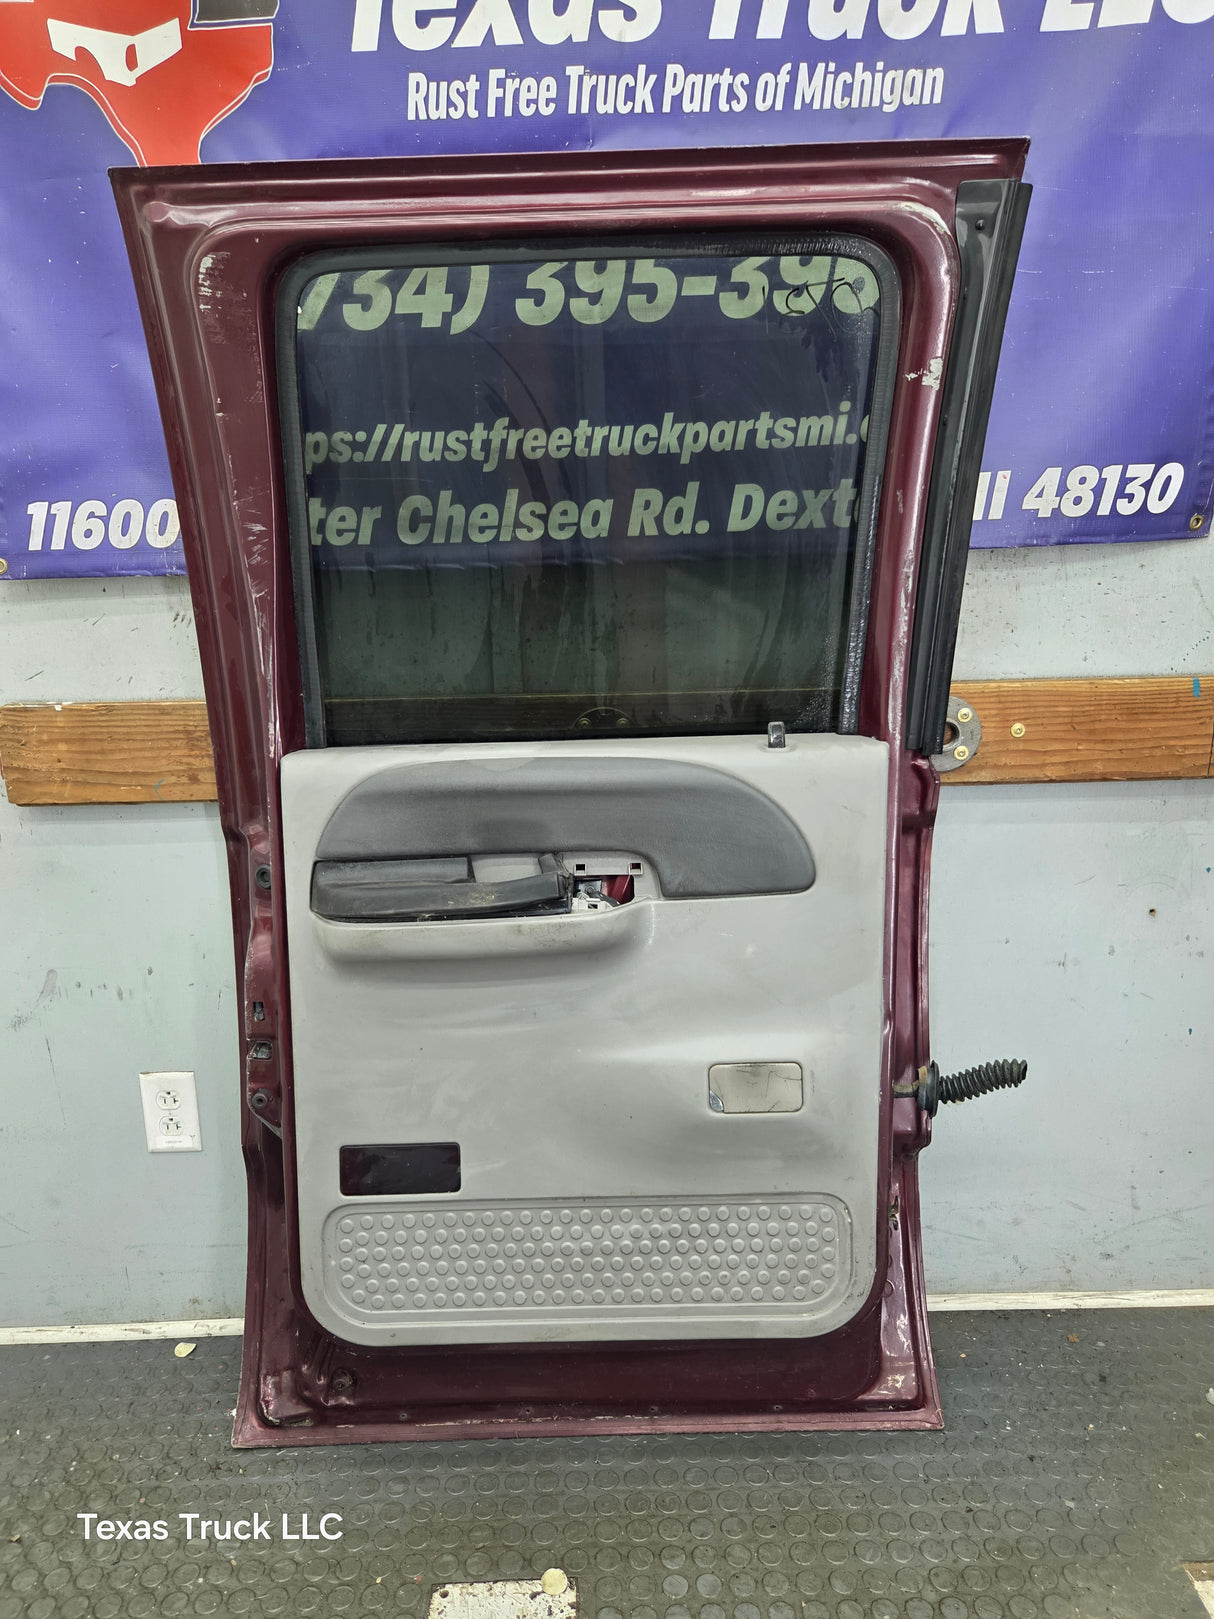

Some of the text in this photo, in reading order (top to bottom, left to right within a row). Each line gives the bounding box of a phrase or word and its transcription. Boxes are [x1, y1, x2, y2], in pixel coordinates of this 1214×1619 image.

[407, 62, 945, 121] Rust Free Truck Parts of Michigan
[27, 499, 181, 551] 11600
[397, 488, 614, 545] Chelsea
[627, 481, 710, 537] Rd.
[726, 478, 860, 533] Dext
[1021, 462, 1185, 518] 48130
